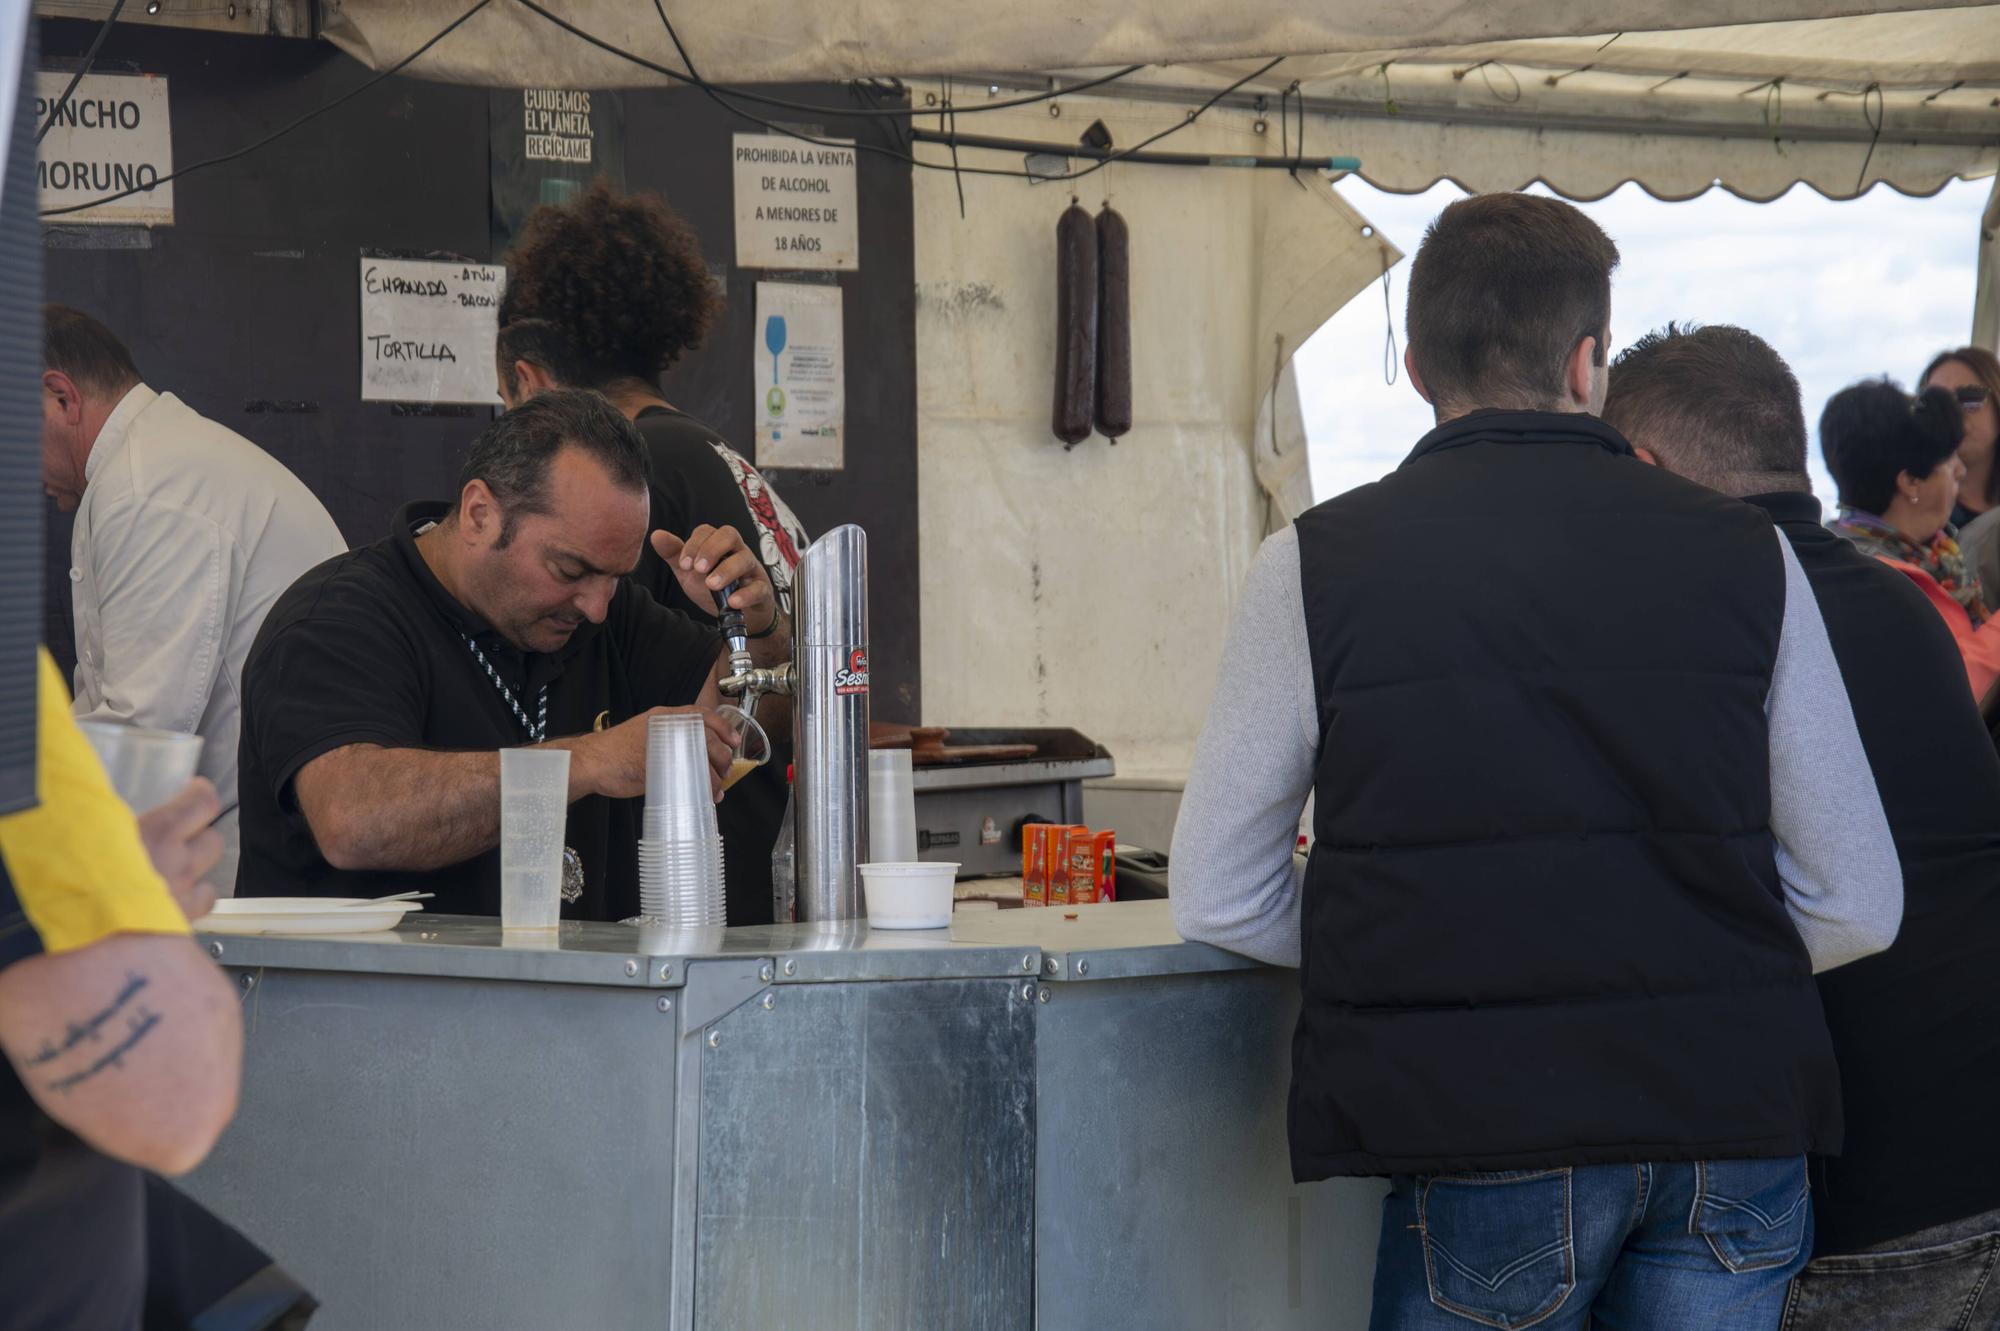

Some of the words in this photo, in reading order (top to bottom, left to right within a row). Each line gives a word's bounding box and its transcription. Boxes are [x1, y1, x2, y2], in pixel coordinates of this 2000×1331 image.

[524, 88, 591, 114] CUIDEMOS
[525, 109, 539, 130] EL
[736, 147, 798, 164] PROHIBIDA
[800, 150, 815, 165] LA
[817, 151, 855, 167] VENTA
[761, 176, 776, 191] DE
[778, 177, 831, 193] ALCOHOL
[755, 206, 765, 220] A
[766, 206, 821, 222] MENORES
[823, 208, 838, 222] DE
[775, 237, 788, 251] 18
[790, 234, 822, 252] AÑOS
[367, 334, 456, 363] TORTILLA
